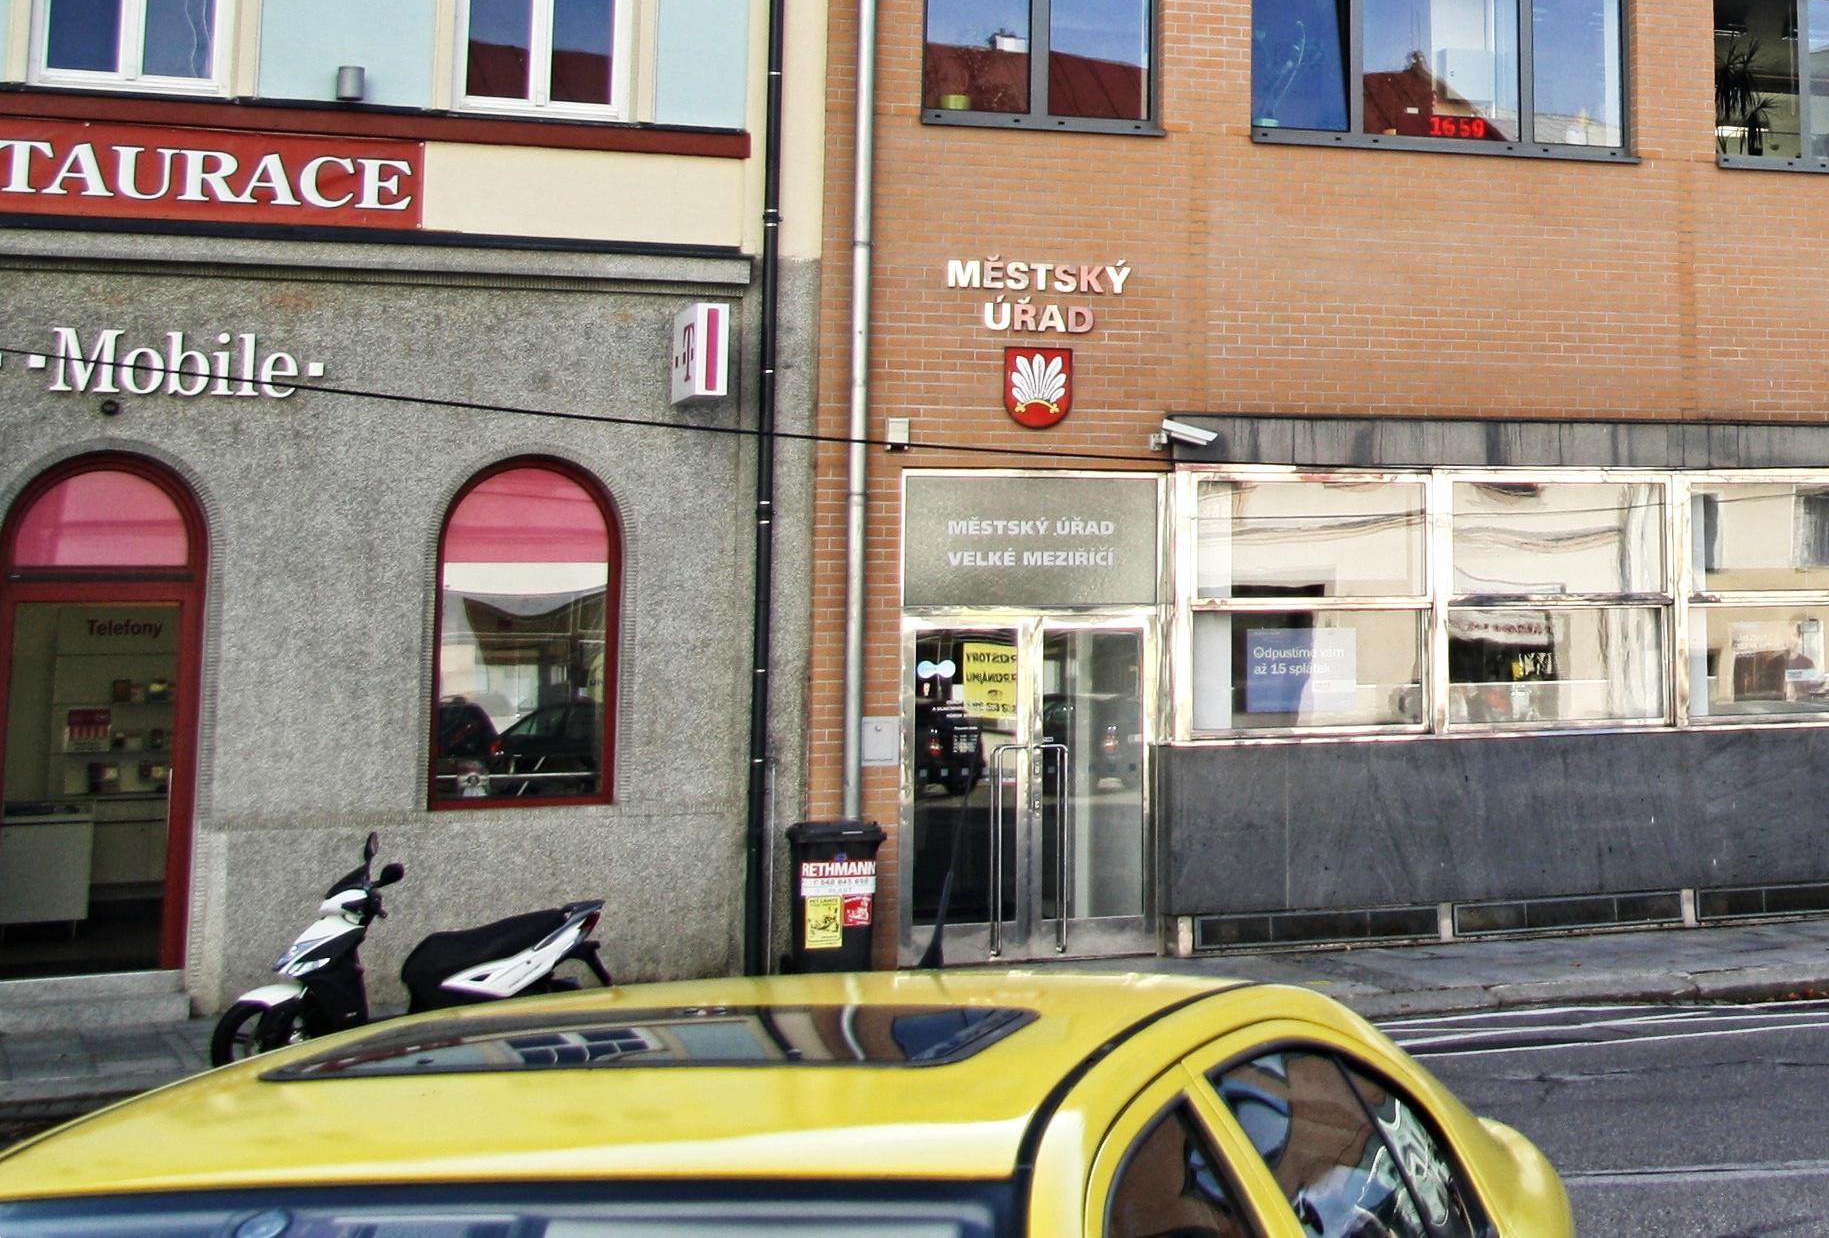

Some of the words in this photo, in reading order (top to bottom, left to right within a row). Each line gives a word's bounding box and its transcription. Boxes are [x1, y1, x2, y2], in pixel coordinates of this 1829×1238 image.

[0, 140, 412, 211] TAURACE
[947, 254, 1131, 294] MĚSTSKÝ
[984, 295, 1095, 333] ÚŘAD
[948, 517, 1048, 535] MĚSTSKÝ
[1056, 517, 1115, 535] ÚŘAD
[948, 548, 1016, 566] VELKÉ
[1023, 547, 1115, 566] MEZIŘÍČÍ
[87, 619, 162, 639] Telefony
[1270, 663, 1287, 675] 15
[802, 861, 876, 877] RETHMANN
